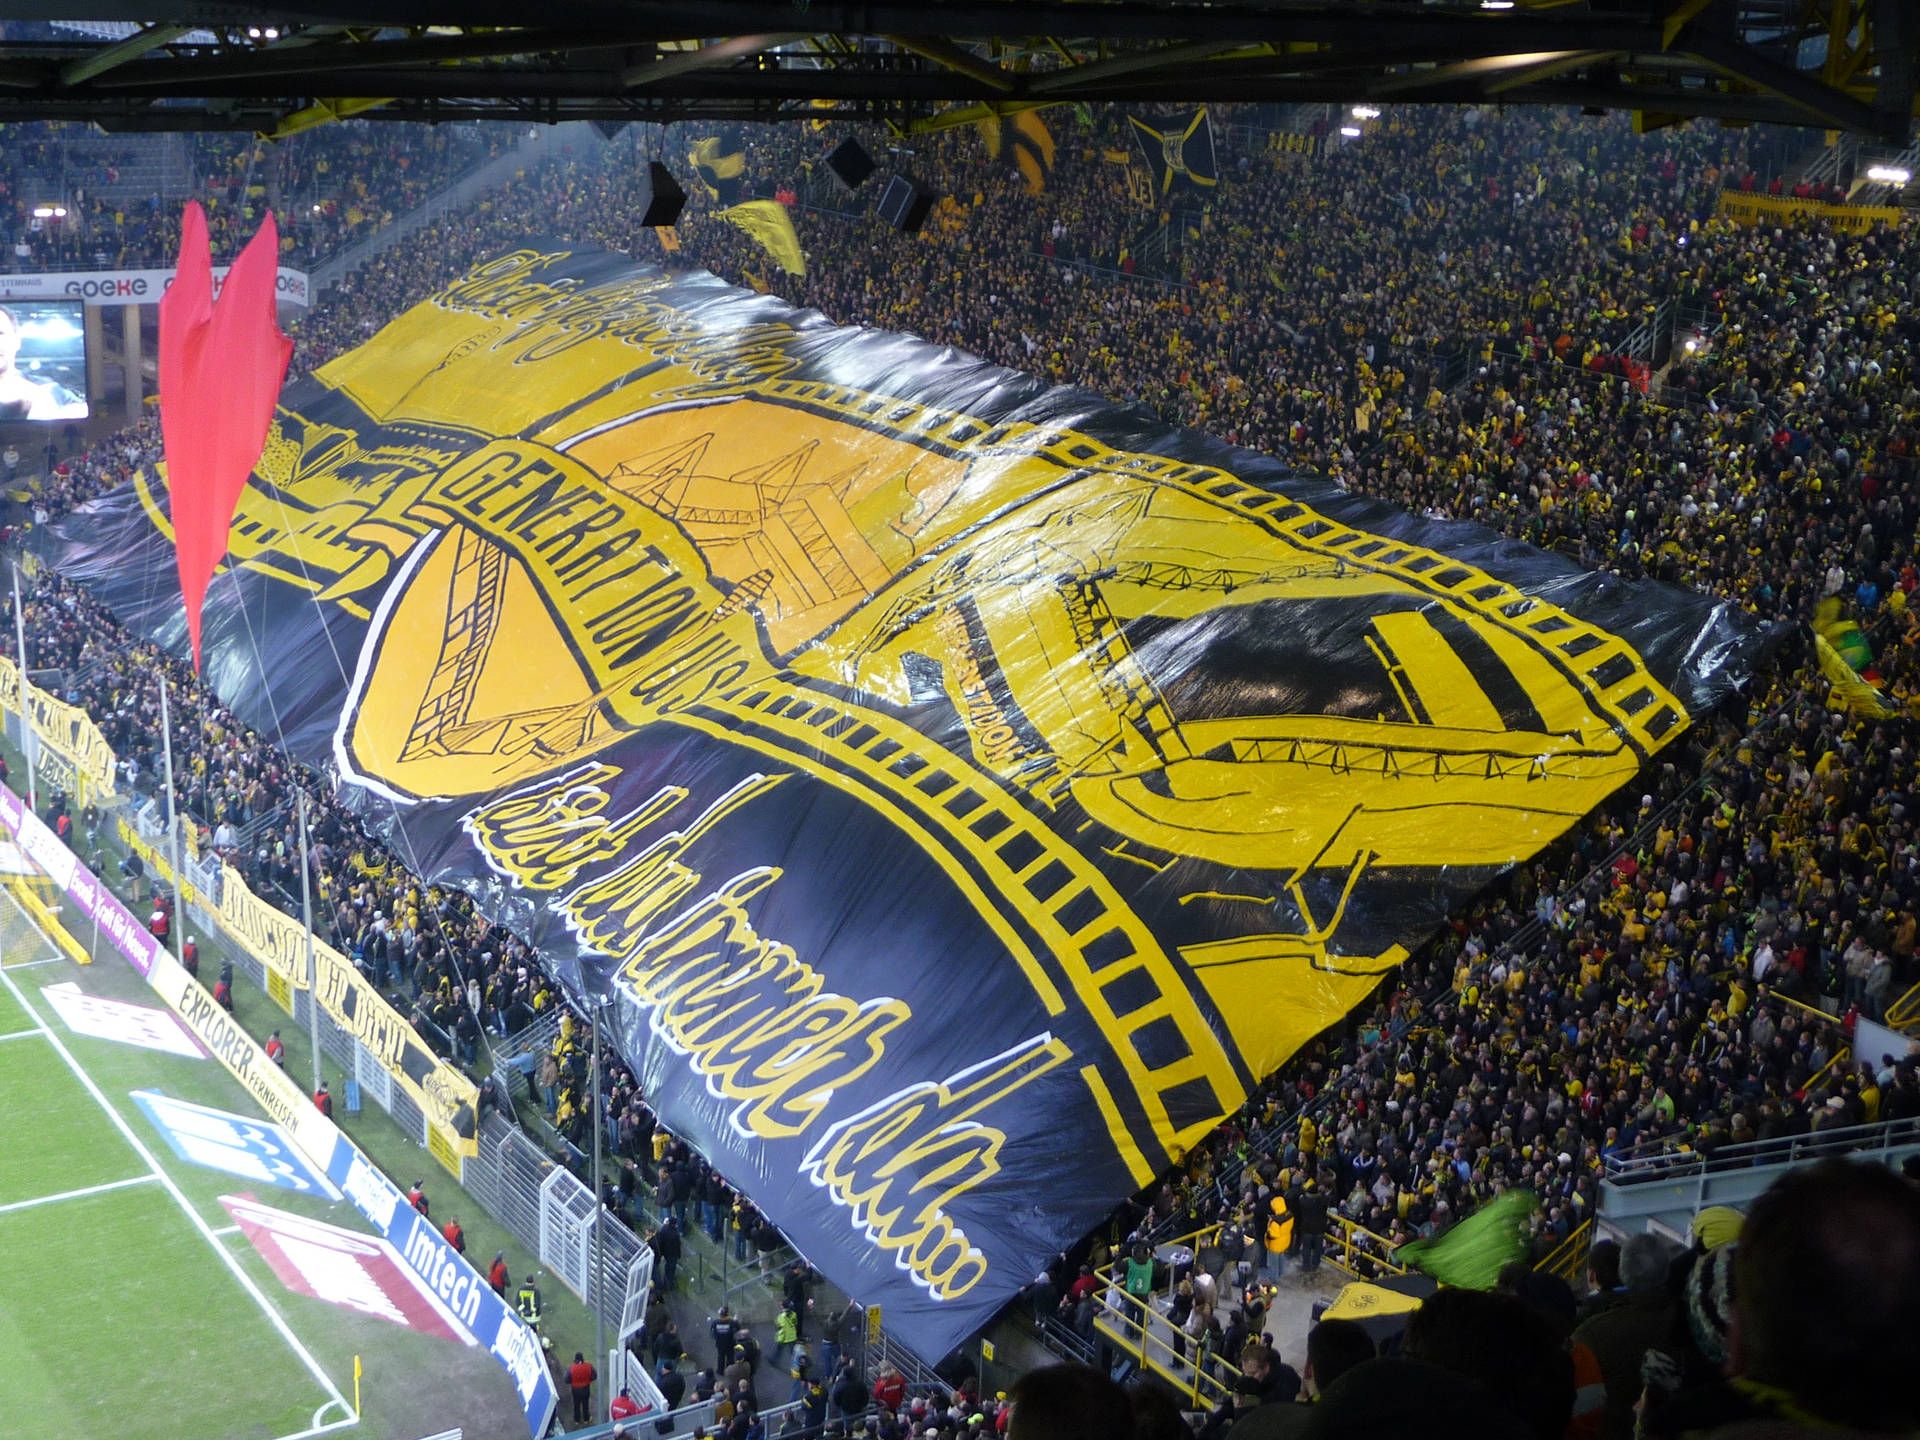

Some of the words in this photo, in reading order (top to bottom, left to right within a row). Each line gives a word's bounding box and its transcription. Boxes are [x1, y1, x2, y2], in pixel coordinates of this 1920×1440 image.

[438, 452, 707, 669] GENERATION
[458, 761, 622, 889] bist
[548, 772, 795, 958] du
[179, 983, 254, 1080] EXPLORER
[248, 1071, 299, 1134] FERNREISEN
[614, 865, 912, 1138] immer
[404, 1215, 482, 1327] Imtech
